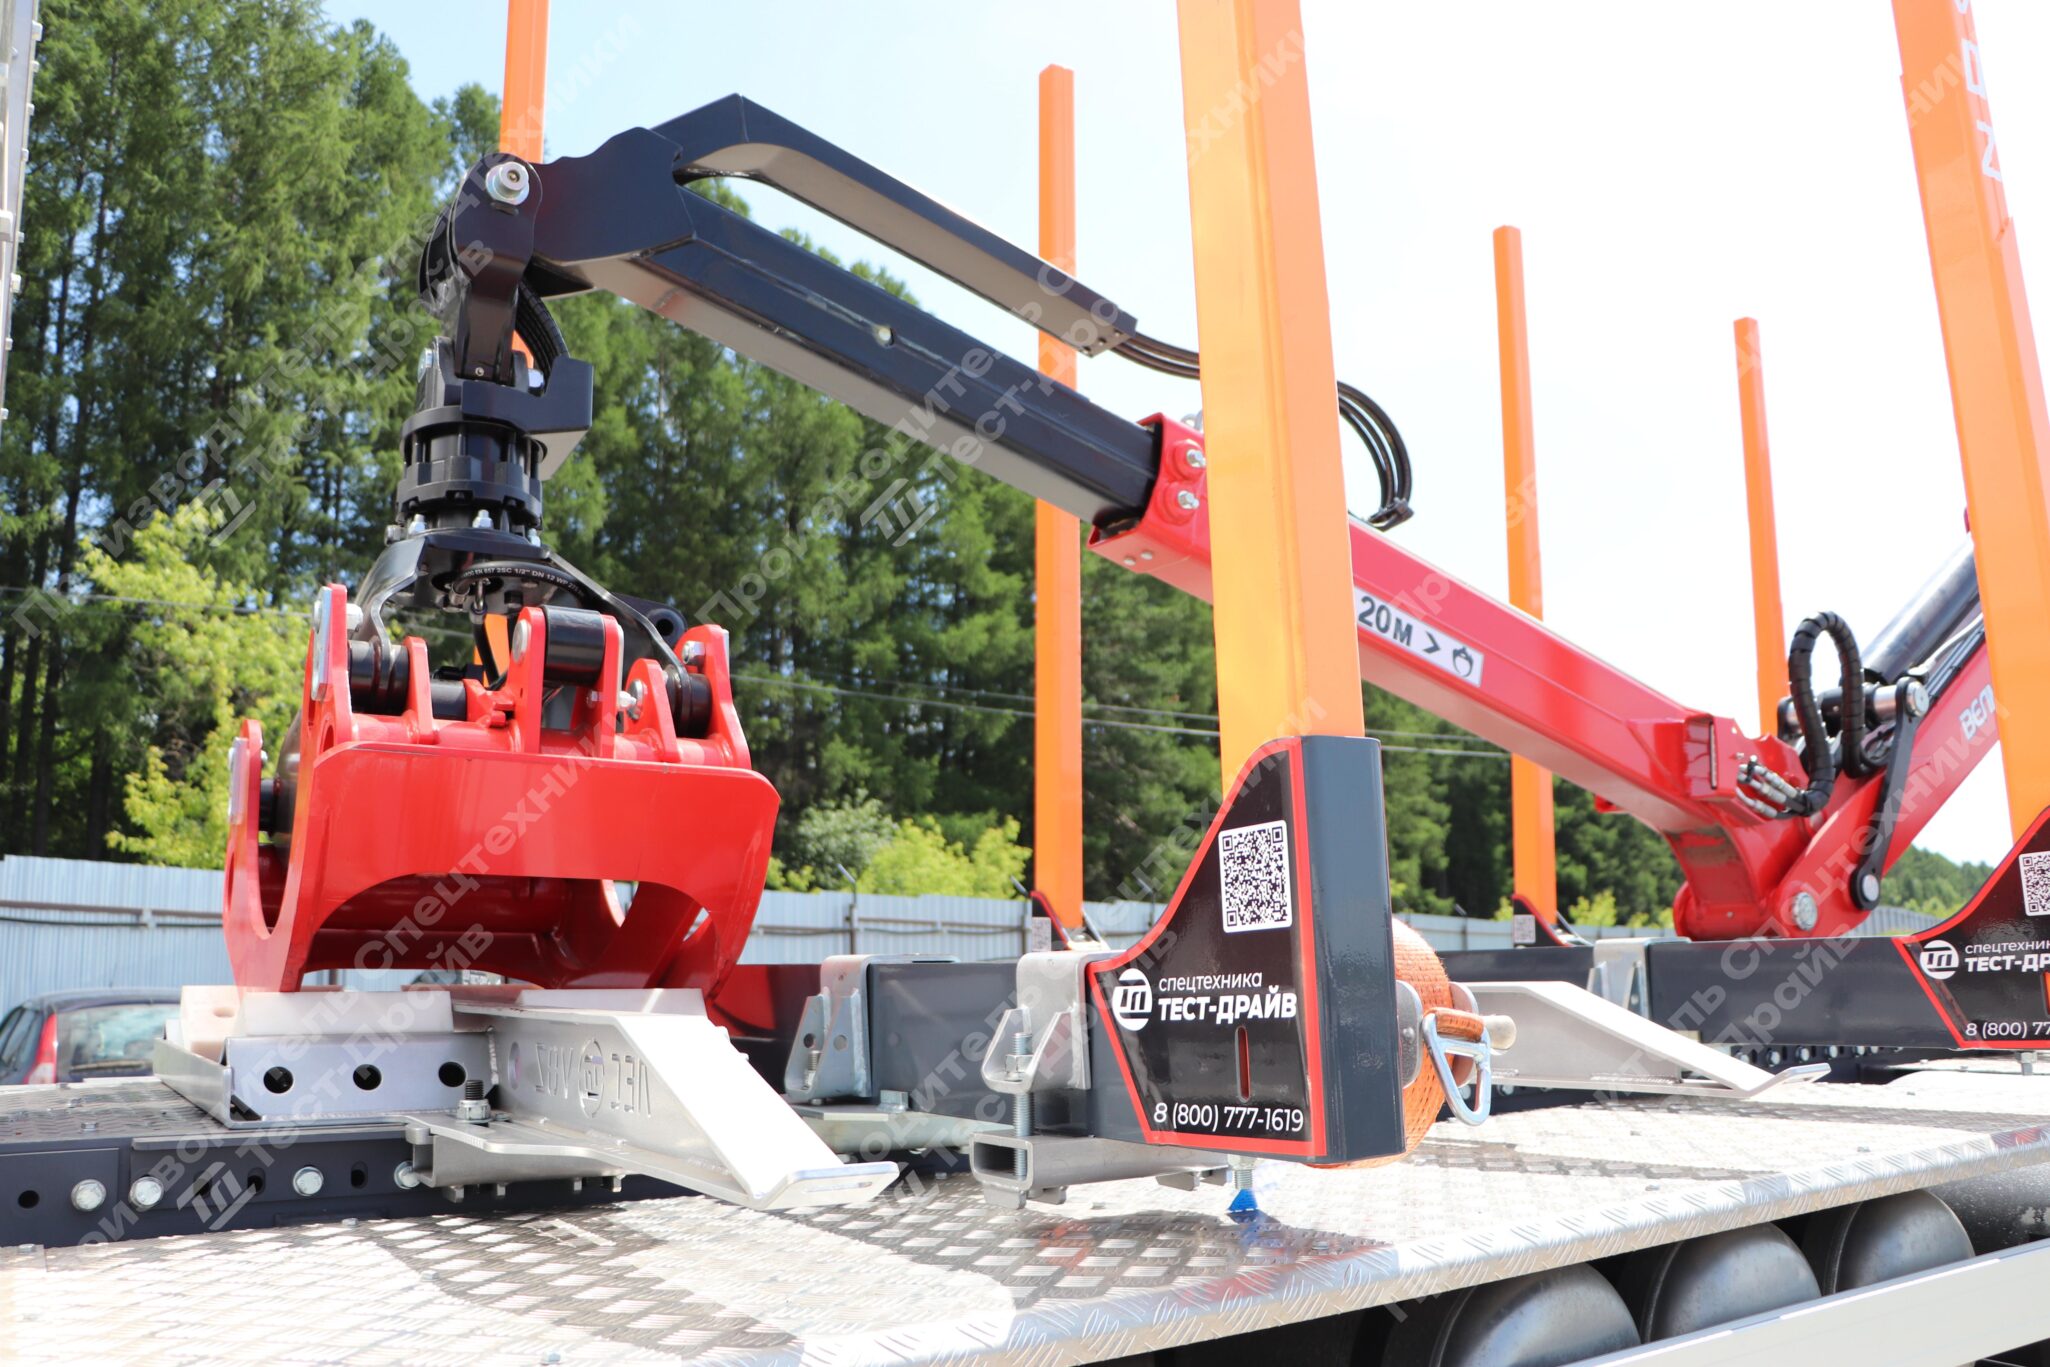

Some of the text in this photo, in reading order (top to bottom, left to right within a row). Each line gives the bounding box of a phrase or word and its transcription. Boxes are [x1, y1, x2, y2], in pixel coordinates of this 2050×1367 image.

[531, 570, 545, 578] DN
[546, 573, 556, 581] 12
[1158, 972, 1263, 993] спецтехника
[1158, 985, 1298, 1025] ТЕСТ-ДРАЙВ
[1965, 1022, 1978, 1036] 8
[1982, 1021, 2028, 1040] (800)
[1153, 1102, 1304, 1132] 8 (800) 777-1619
